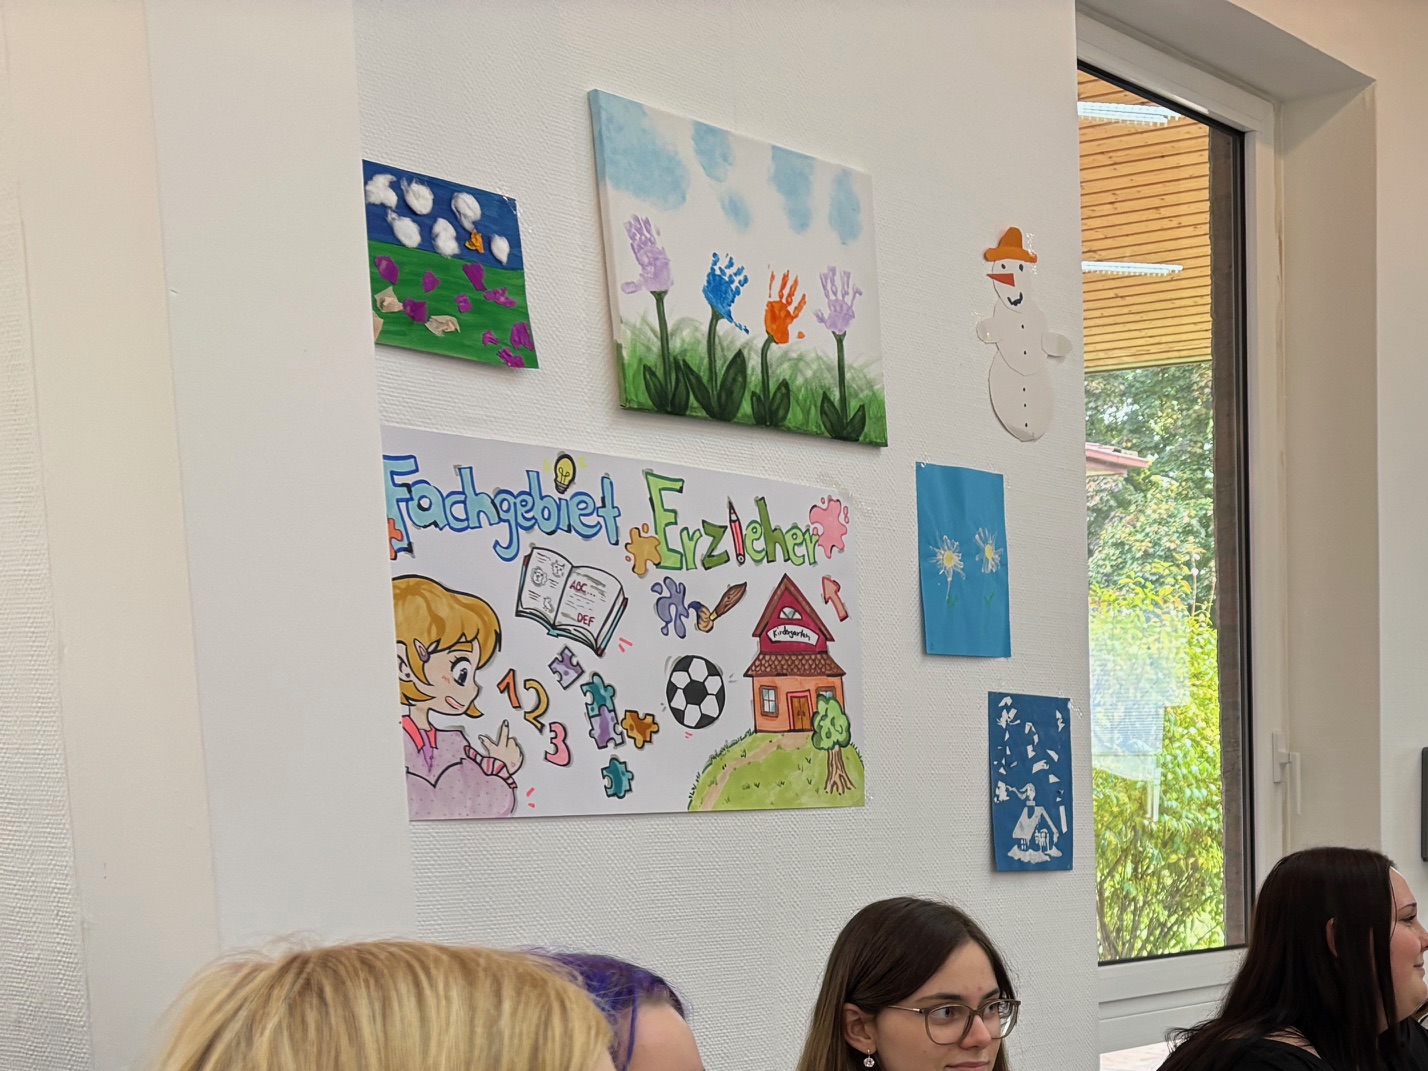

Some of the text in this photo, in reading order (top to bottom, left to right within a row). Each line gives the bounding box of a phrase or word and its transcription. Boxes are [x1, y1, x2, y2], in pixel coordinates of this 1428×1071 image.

[382, 454, 819, 572] Fachgebiet Erzieher
[577, 612, 596, 627] DEF
[772, 626, 811, 642] Kindergarten
